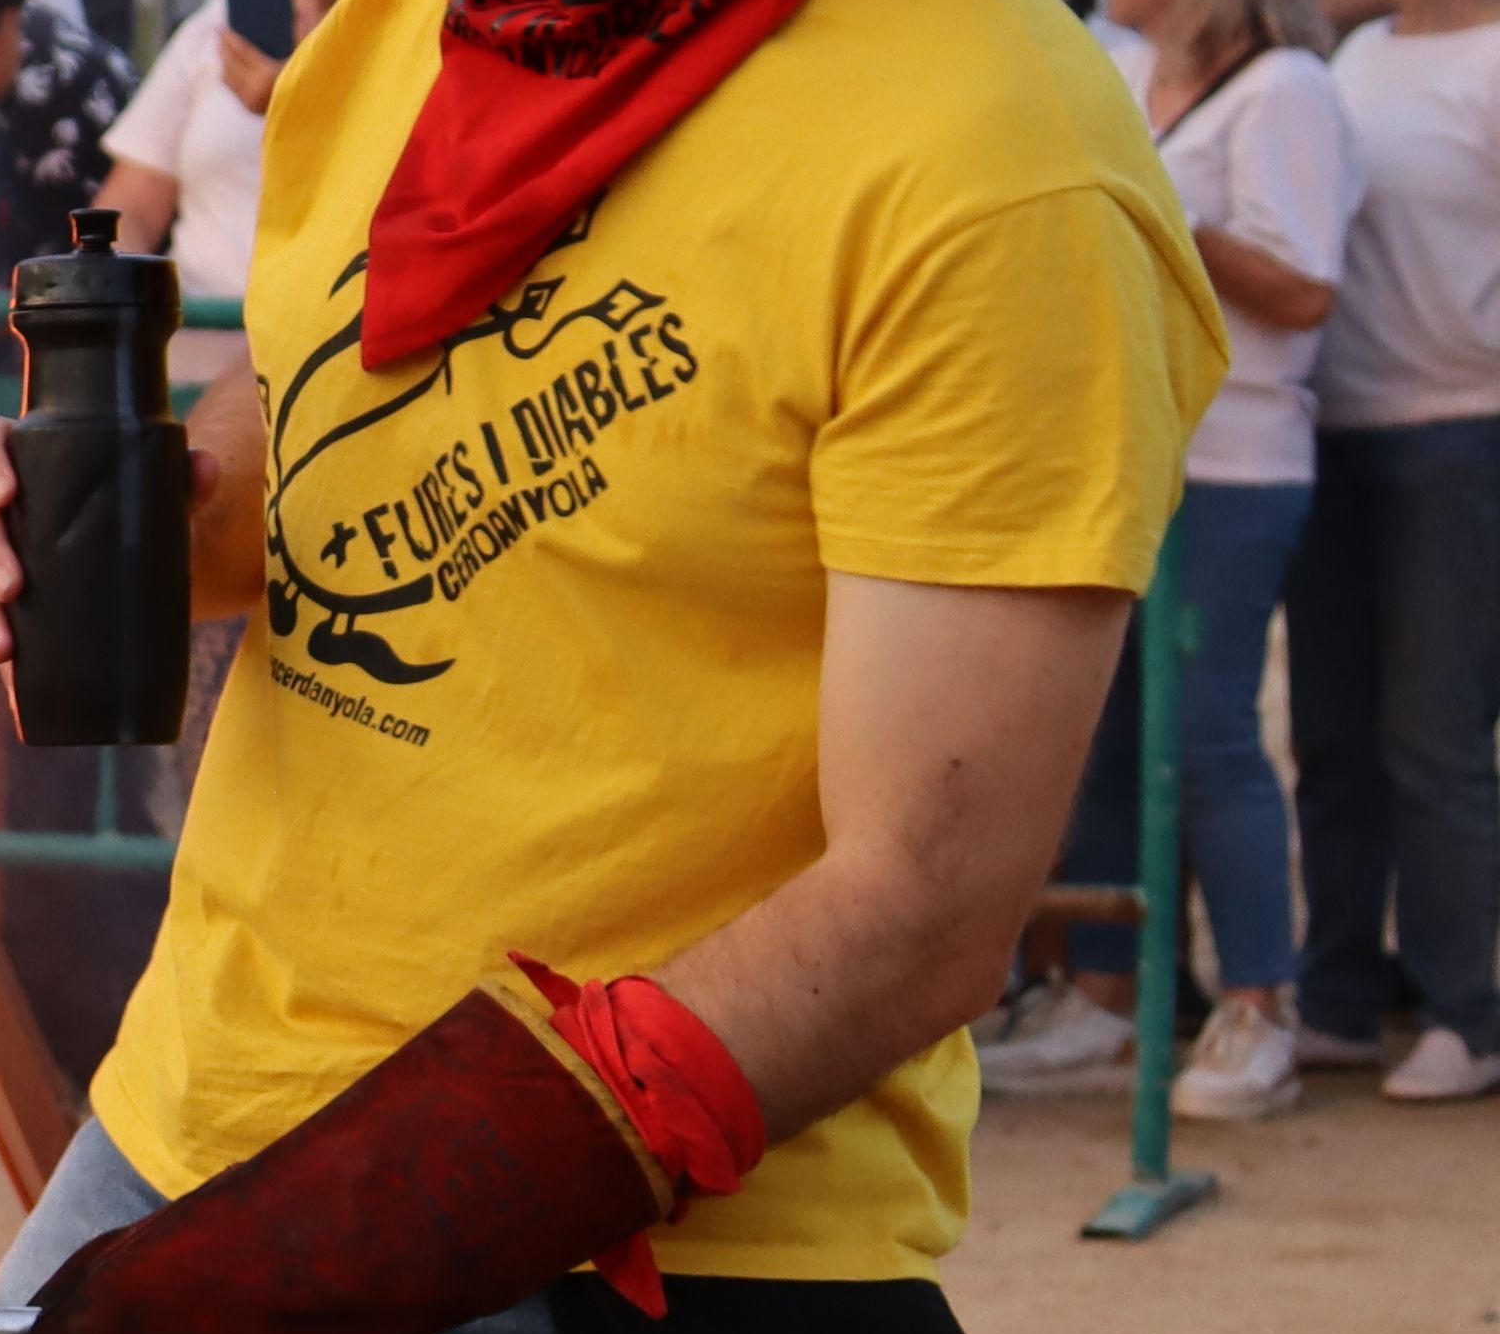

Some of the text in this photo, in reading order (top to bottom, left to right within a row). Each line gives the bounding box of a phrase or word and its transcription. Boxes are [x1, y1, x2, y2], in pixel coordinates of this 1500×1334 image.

[363, 312, 699, 580] FURES I DIABLES
[436, 455, 608, 602] CERDANYOLA
